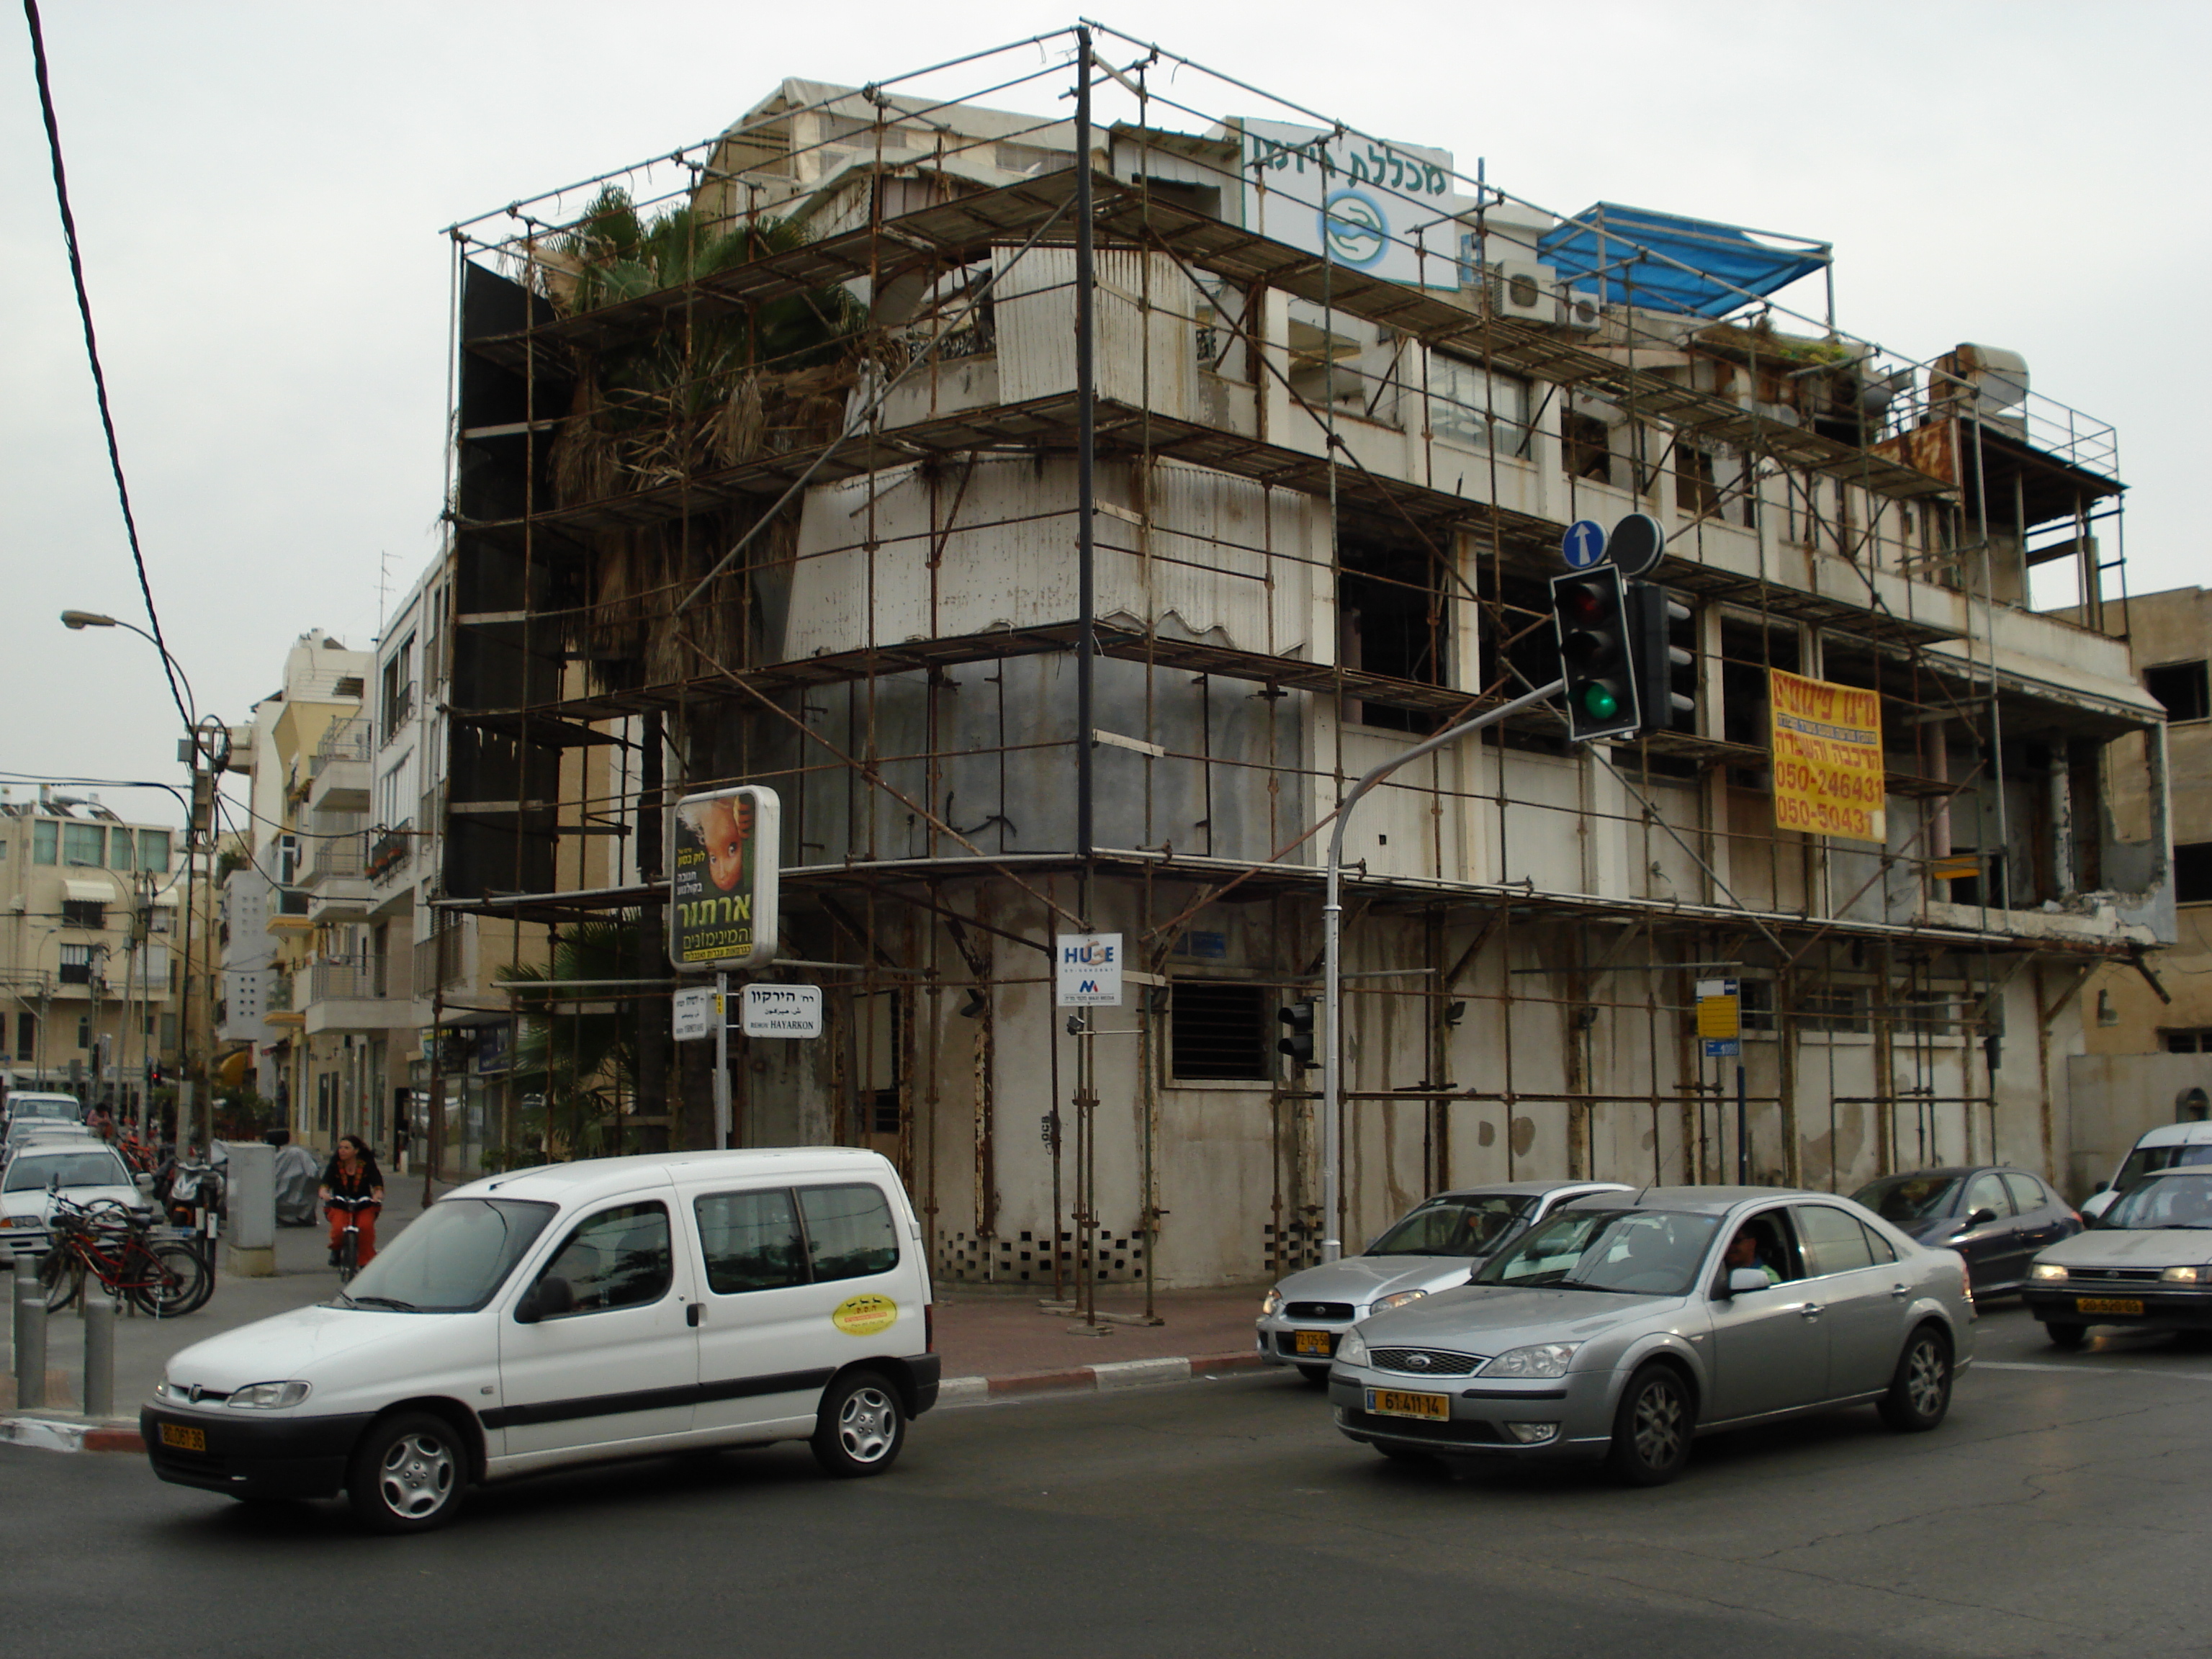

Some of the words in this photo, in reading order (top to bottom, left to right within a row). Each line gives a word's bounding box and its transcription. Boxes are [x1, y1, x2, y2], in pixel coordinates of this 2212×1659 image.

[1346, 143, 1447, 196] מכללת
[1775, 760, 1883, 804] 050-246431
[677, 894, 752, 928] ארתור
[1064, 940, 1115, 965] HUGE
[751, 990, 796, 1004] הירקון
[770, 1020, 814, 1030] HAYARKON
